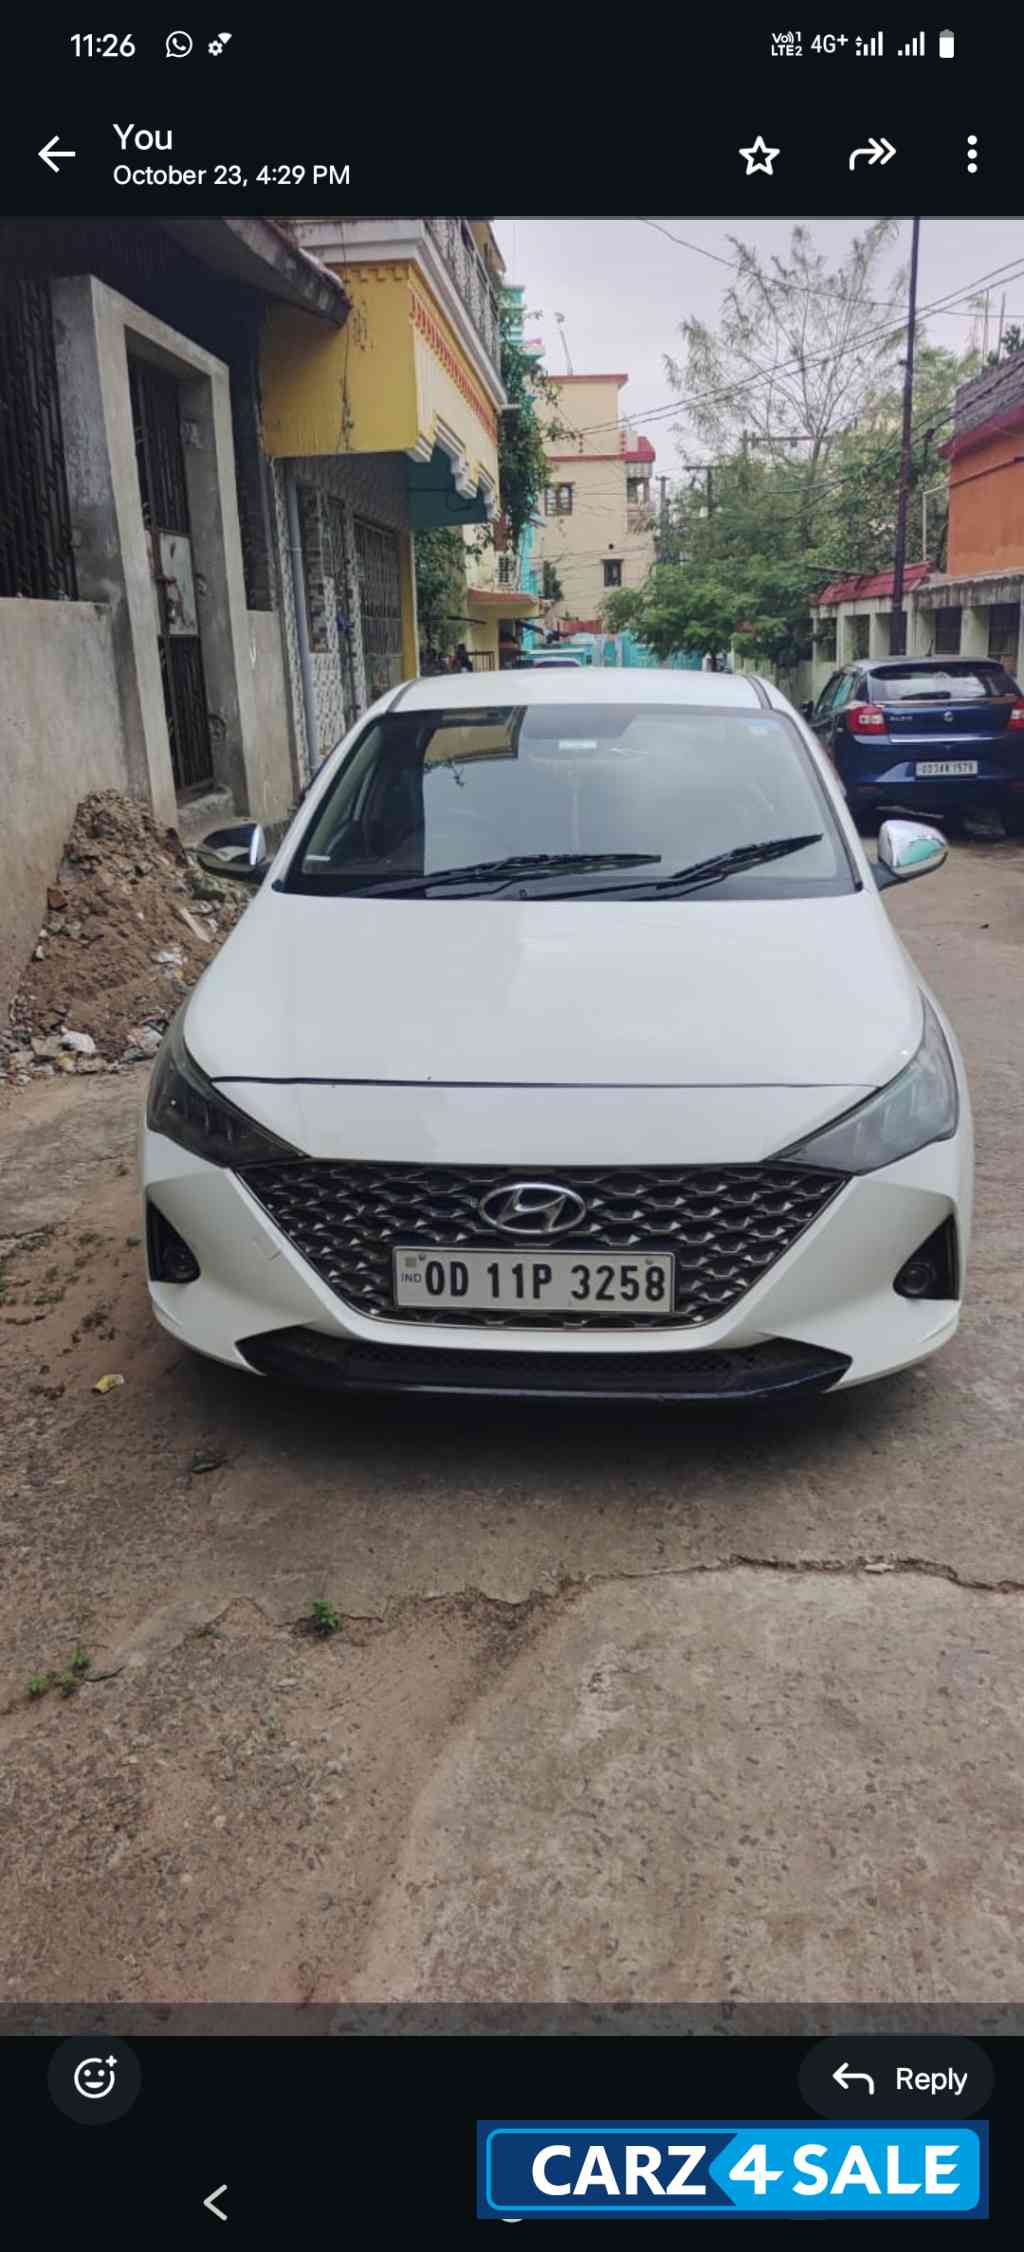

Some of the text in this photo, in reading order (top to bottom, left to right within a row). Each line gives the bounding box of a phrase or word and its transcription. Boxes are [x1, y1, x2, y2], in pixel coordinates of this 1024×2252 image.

[400, 1271, 422, 1284] IND
[425, 1260, 665, 1302] OD 11P 3258
